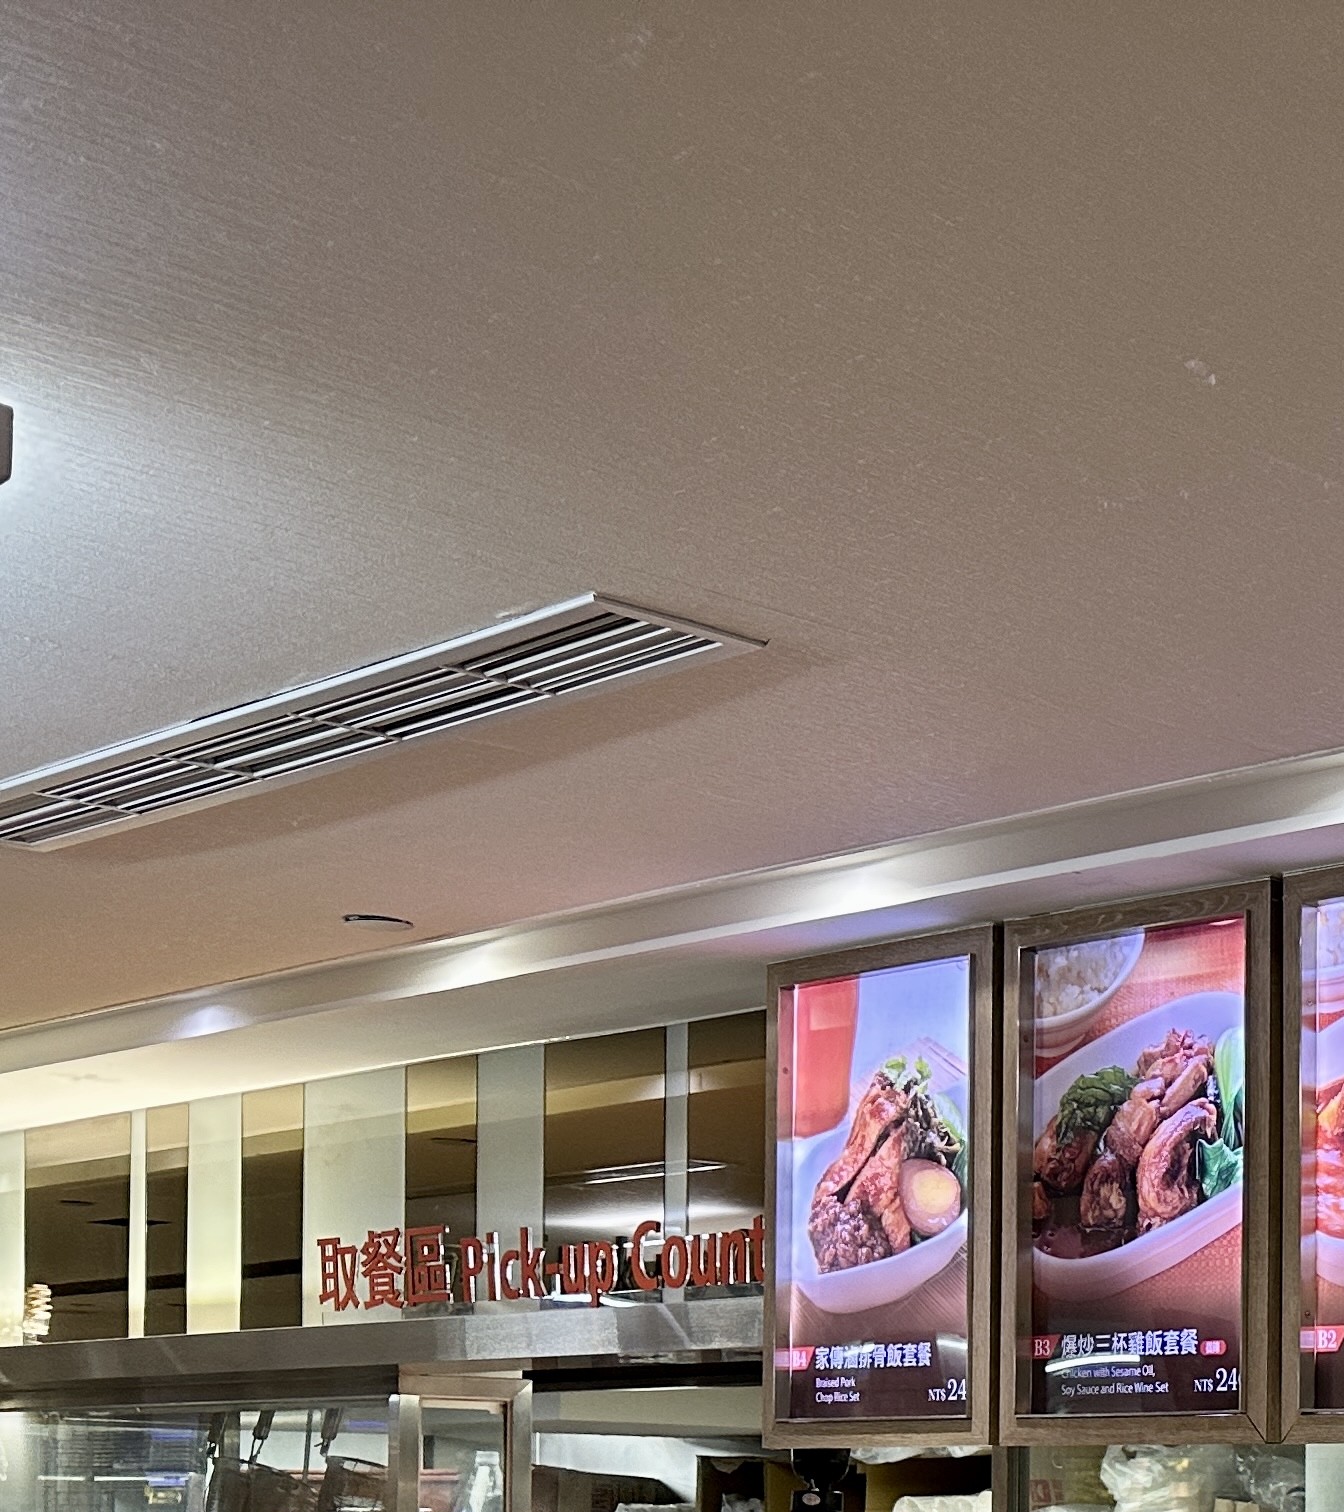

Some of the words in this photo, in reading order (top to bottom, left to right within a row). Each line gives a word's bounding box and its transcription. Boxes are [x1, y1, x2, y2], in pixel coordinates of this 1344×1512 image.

[316, 1225, 451, 1312] 取餐區
[460, 1226, 617, 1307] Pick-up
[1034, 1339, 1050, 1357] B3
[1061, 1328, 1199, 1359] 爆炒三杯雞飯套餐
[1317, 1329, 1338, 1349] B2
[793, 1351, 807, 1367] B4
[1193, 1379, 1213, 1392] NT$
[1215, 1367, 1241, 1392] 24
[849, 1391, 860, 1402] Set
[928, 1388, 946, 1402] NT$
[1061, 1384, 1075, 1397] Soy
[1077, 1383, 1099, 1395] Sauce
[1100, 1383, 1115, 1394] and
[1116, 1382, 1133, 1394] Rice
[1134, 1381, 1154, 1393] Wine
[1156, 1381, 1169, 1393] Set
